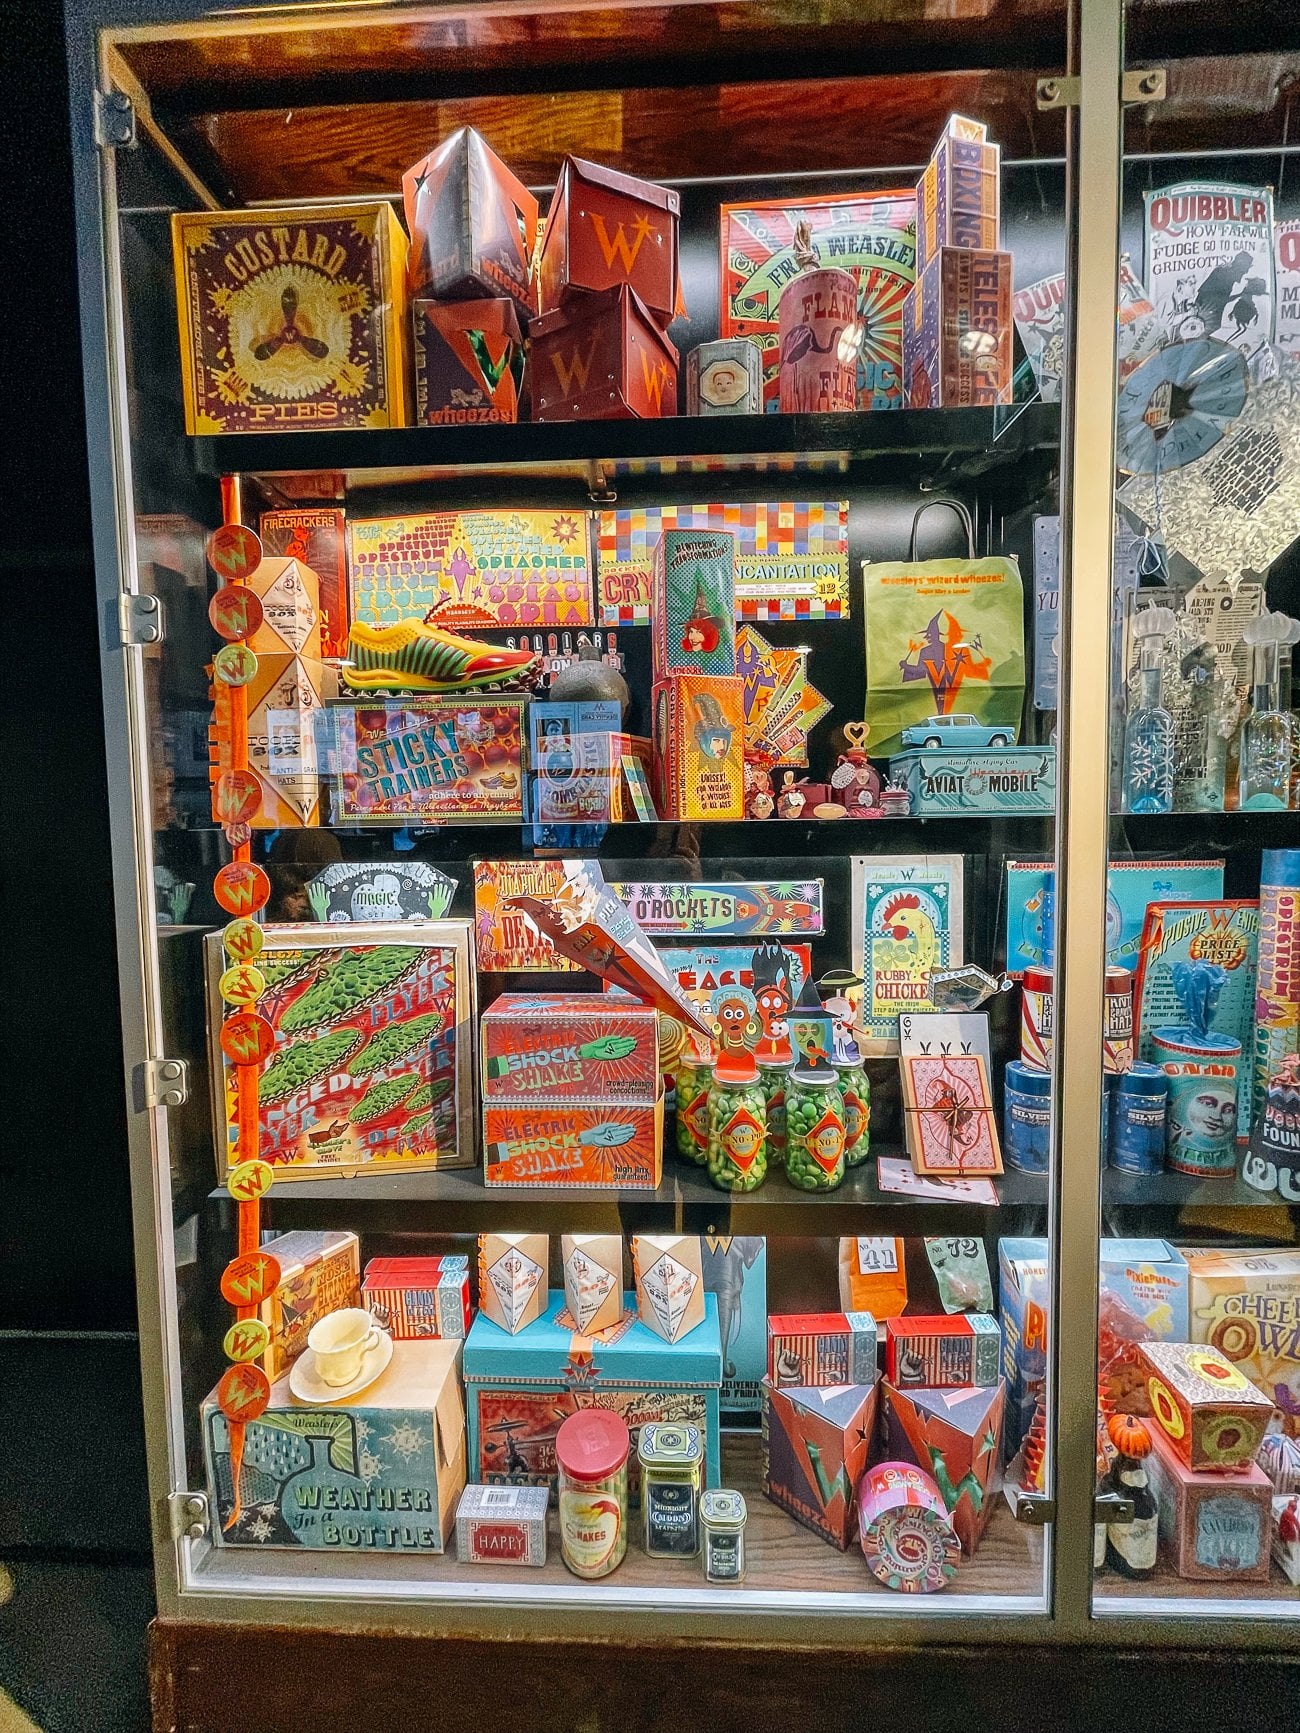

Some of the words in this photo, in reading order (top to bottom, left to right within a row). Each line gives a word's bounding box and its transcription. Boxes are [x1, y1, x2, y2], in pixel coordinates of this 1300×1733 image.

[954, 141, 982, 249] BOXING
[1150, 194, 1268, 238] QUIBBLER
[1186, 225, 1217, 239] HOW
[1220, 225, 1246, 239] FAR
[1249, 226, 1269, 239] WILL
[223, 227, 348, 282] CUSTARD
[1152, 240, 1200, 260] FUDGE
[1203, 240, 1216, 252] GO
[1219, 240, 1231, 252] TO
[1233, 240, 1257, 252] GAIN
[1152, 255, 1234, 276] GRINGOTTS?
[972, 253, 1000, 406] TELESOPE
[249, 401, 339, 423] PIES
[263, 516, 336, 530] FIRECRACKERS
[357, 548, 445, 564] SPECTRUM
[477, 555, 586, 570] SPLASHER
[818, 582, 836, 596] 12
[356, 718, 461, 779] STICKY
[366, 754, 470, 803] TRAINERS
[988, 774, 1039, 793] MOBILE
[428, 791, 461, 801] adhere
[501, 873, 555, 897] DIABOLIC
[356, 891, 394, 906] MAGIC
[599, 899, 618, 923] PICK
[1200, 939, 1241, 950] PRICE
[696, 953, 720, 965] THE
[1202, 950, 1234, 960] LIST
[875, 970, 912, 981] RUBBY
[370, 970, 450, 1028] FLYER
[875, 983, 929, 1000] CHICKE
[508, 1046, 579, 1072] SHOCK
[509, 1061, 585, 1092] SHAKE
[508, 1132, 579, 1158] SHOCK
[511, 1147, 585, 1178] SHAKE
[614, 1165, 633, 1175] high
[863, 1252, 896, 1270] 41
[296, 1486, 433, 1512] WEATHER
[654, 1504, 689, 1513] MIDNIGHT
[321, 1511, 335, 1523] a
[323, 1525, 435, 1549] BOTTLE
[479, 1535, 525, 1551] HAPPY
